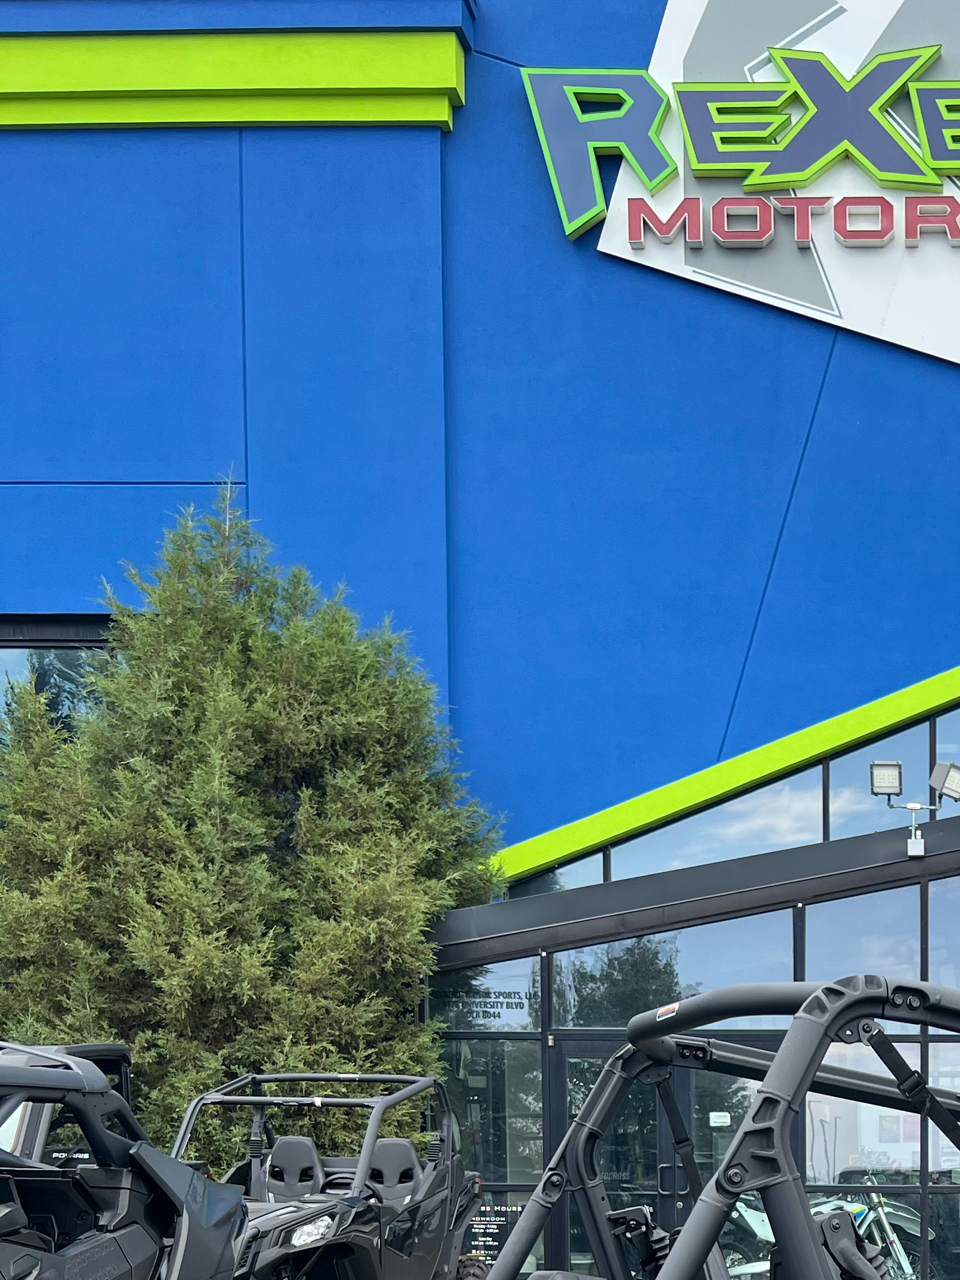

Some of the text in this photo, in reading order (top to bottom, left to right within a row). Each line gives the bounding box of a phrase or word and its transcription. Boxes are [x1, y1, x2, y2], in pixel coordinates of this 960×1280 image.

[493, 991, 523, 1001] SPORTS,
[462, 1000, 504, 1009] UNIVERSITY
[505, 1001, 525, 1010] BLVD
[482, 1010, 501, 1019] 8044
